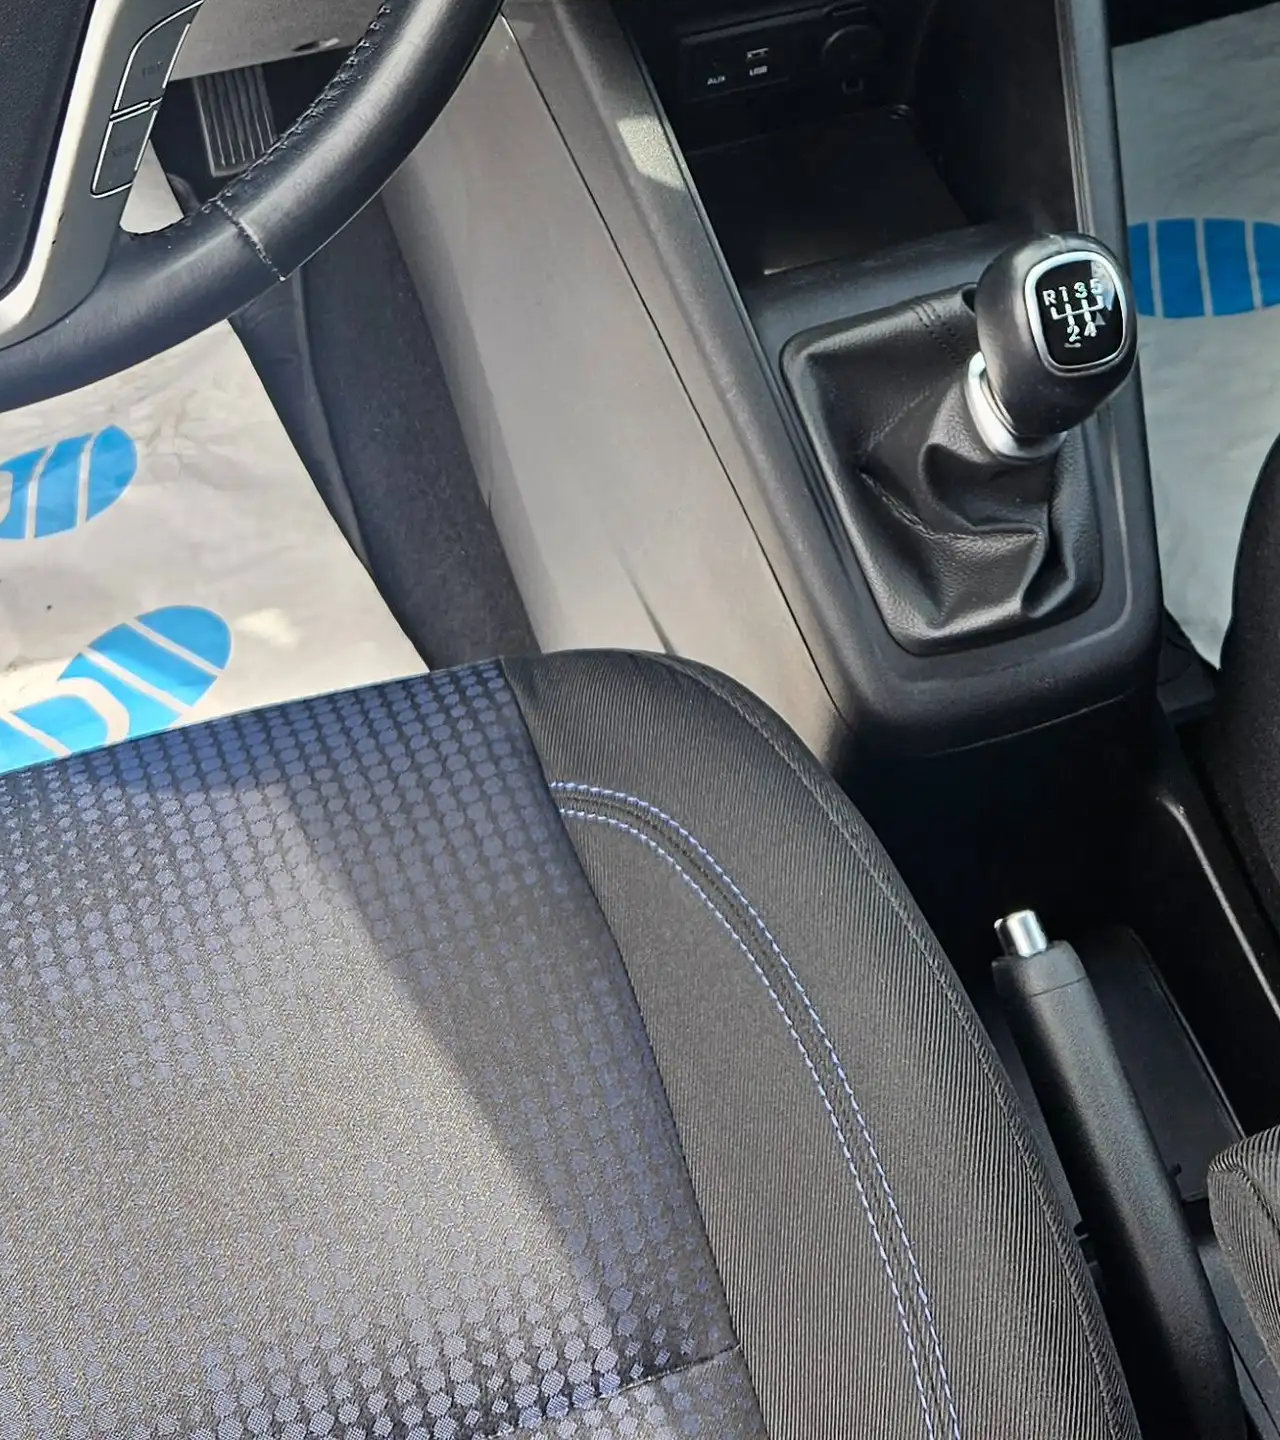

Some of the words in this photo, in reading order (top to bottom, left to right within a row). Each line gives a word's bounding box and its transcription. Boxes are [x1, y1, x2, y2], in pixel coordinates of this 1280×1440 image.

[1042, 290, 1058, 306] R
[1074, 281, 1088, 299] 3
[1089, 278, 1103, 294] 5
[1067, 324, 1082, 342] 2
